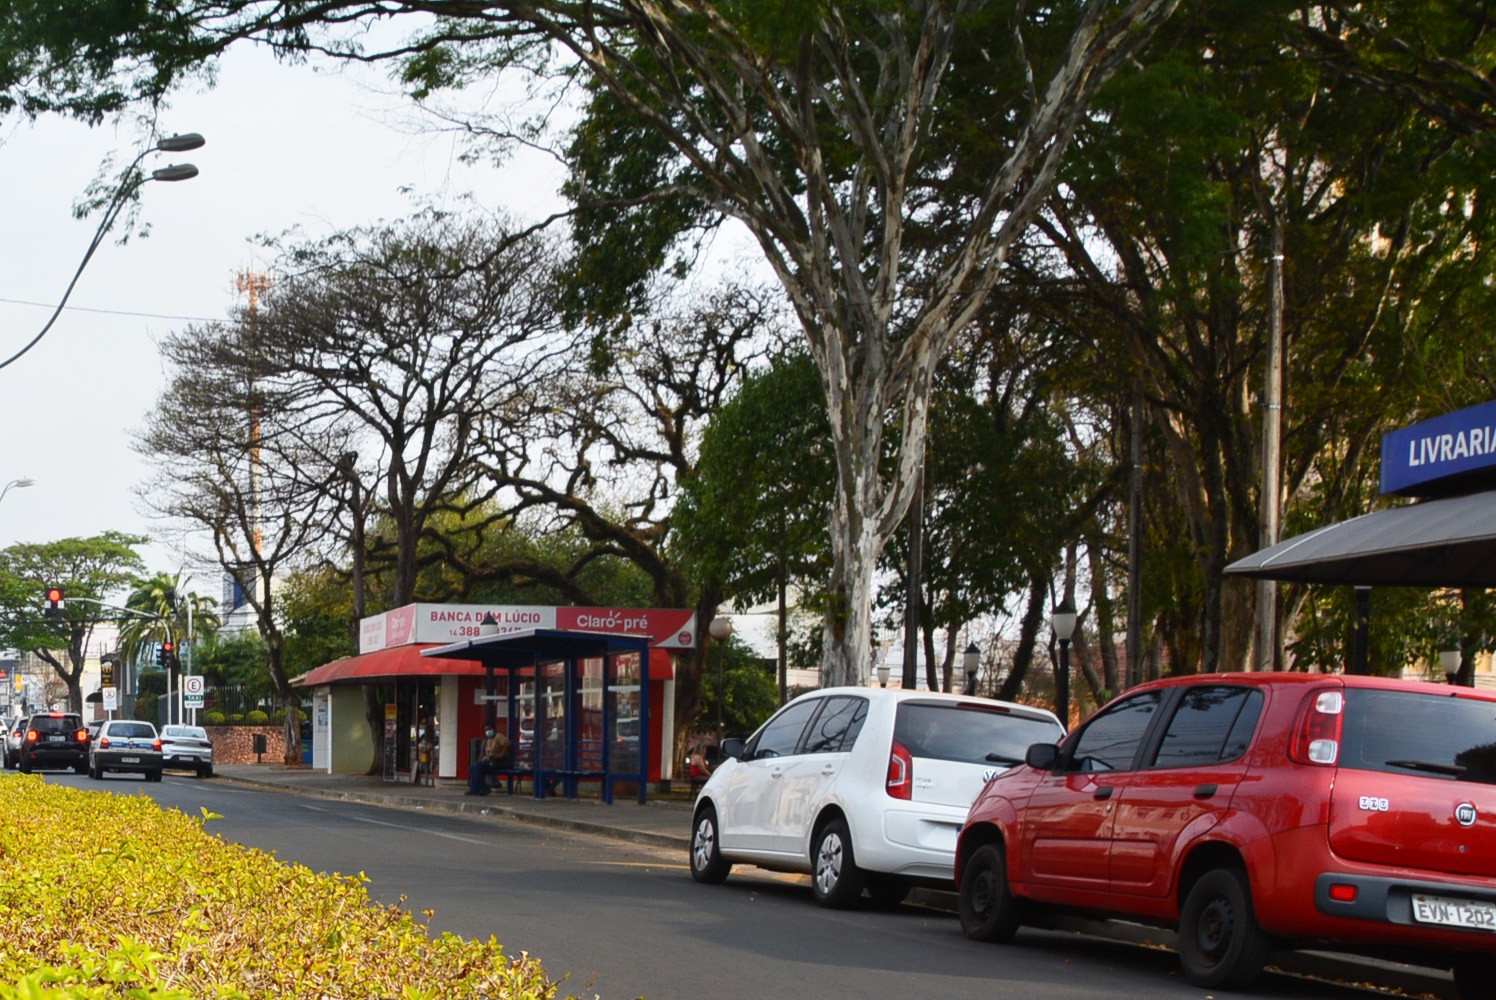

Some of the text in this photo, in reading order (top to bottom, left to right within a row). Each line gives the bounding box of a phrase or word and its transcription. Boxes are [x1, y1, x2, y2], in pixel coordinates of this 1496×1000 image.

[430, 611, 472, 622] BANCA
[505, 609, 541, 624] LÚCIO
[191, 681, 197, 690] E
[1418, 902, 1496, 926] EVN-1202
